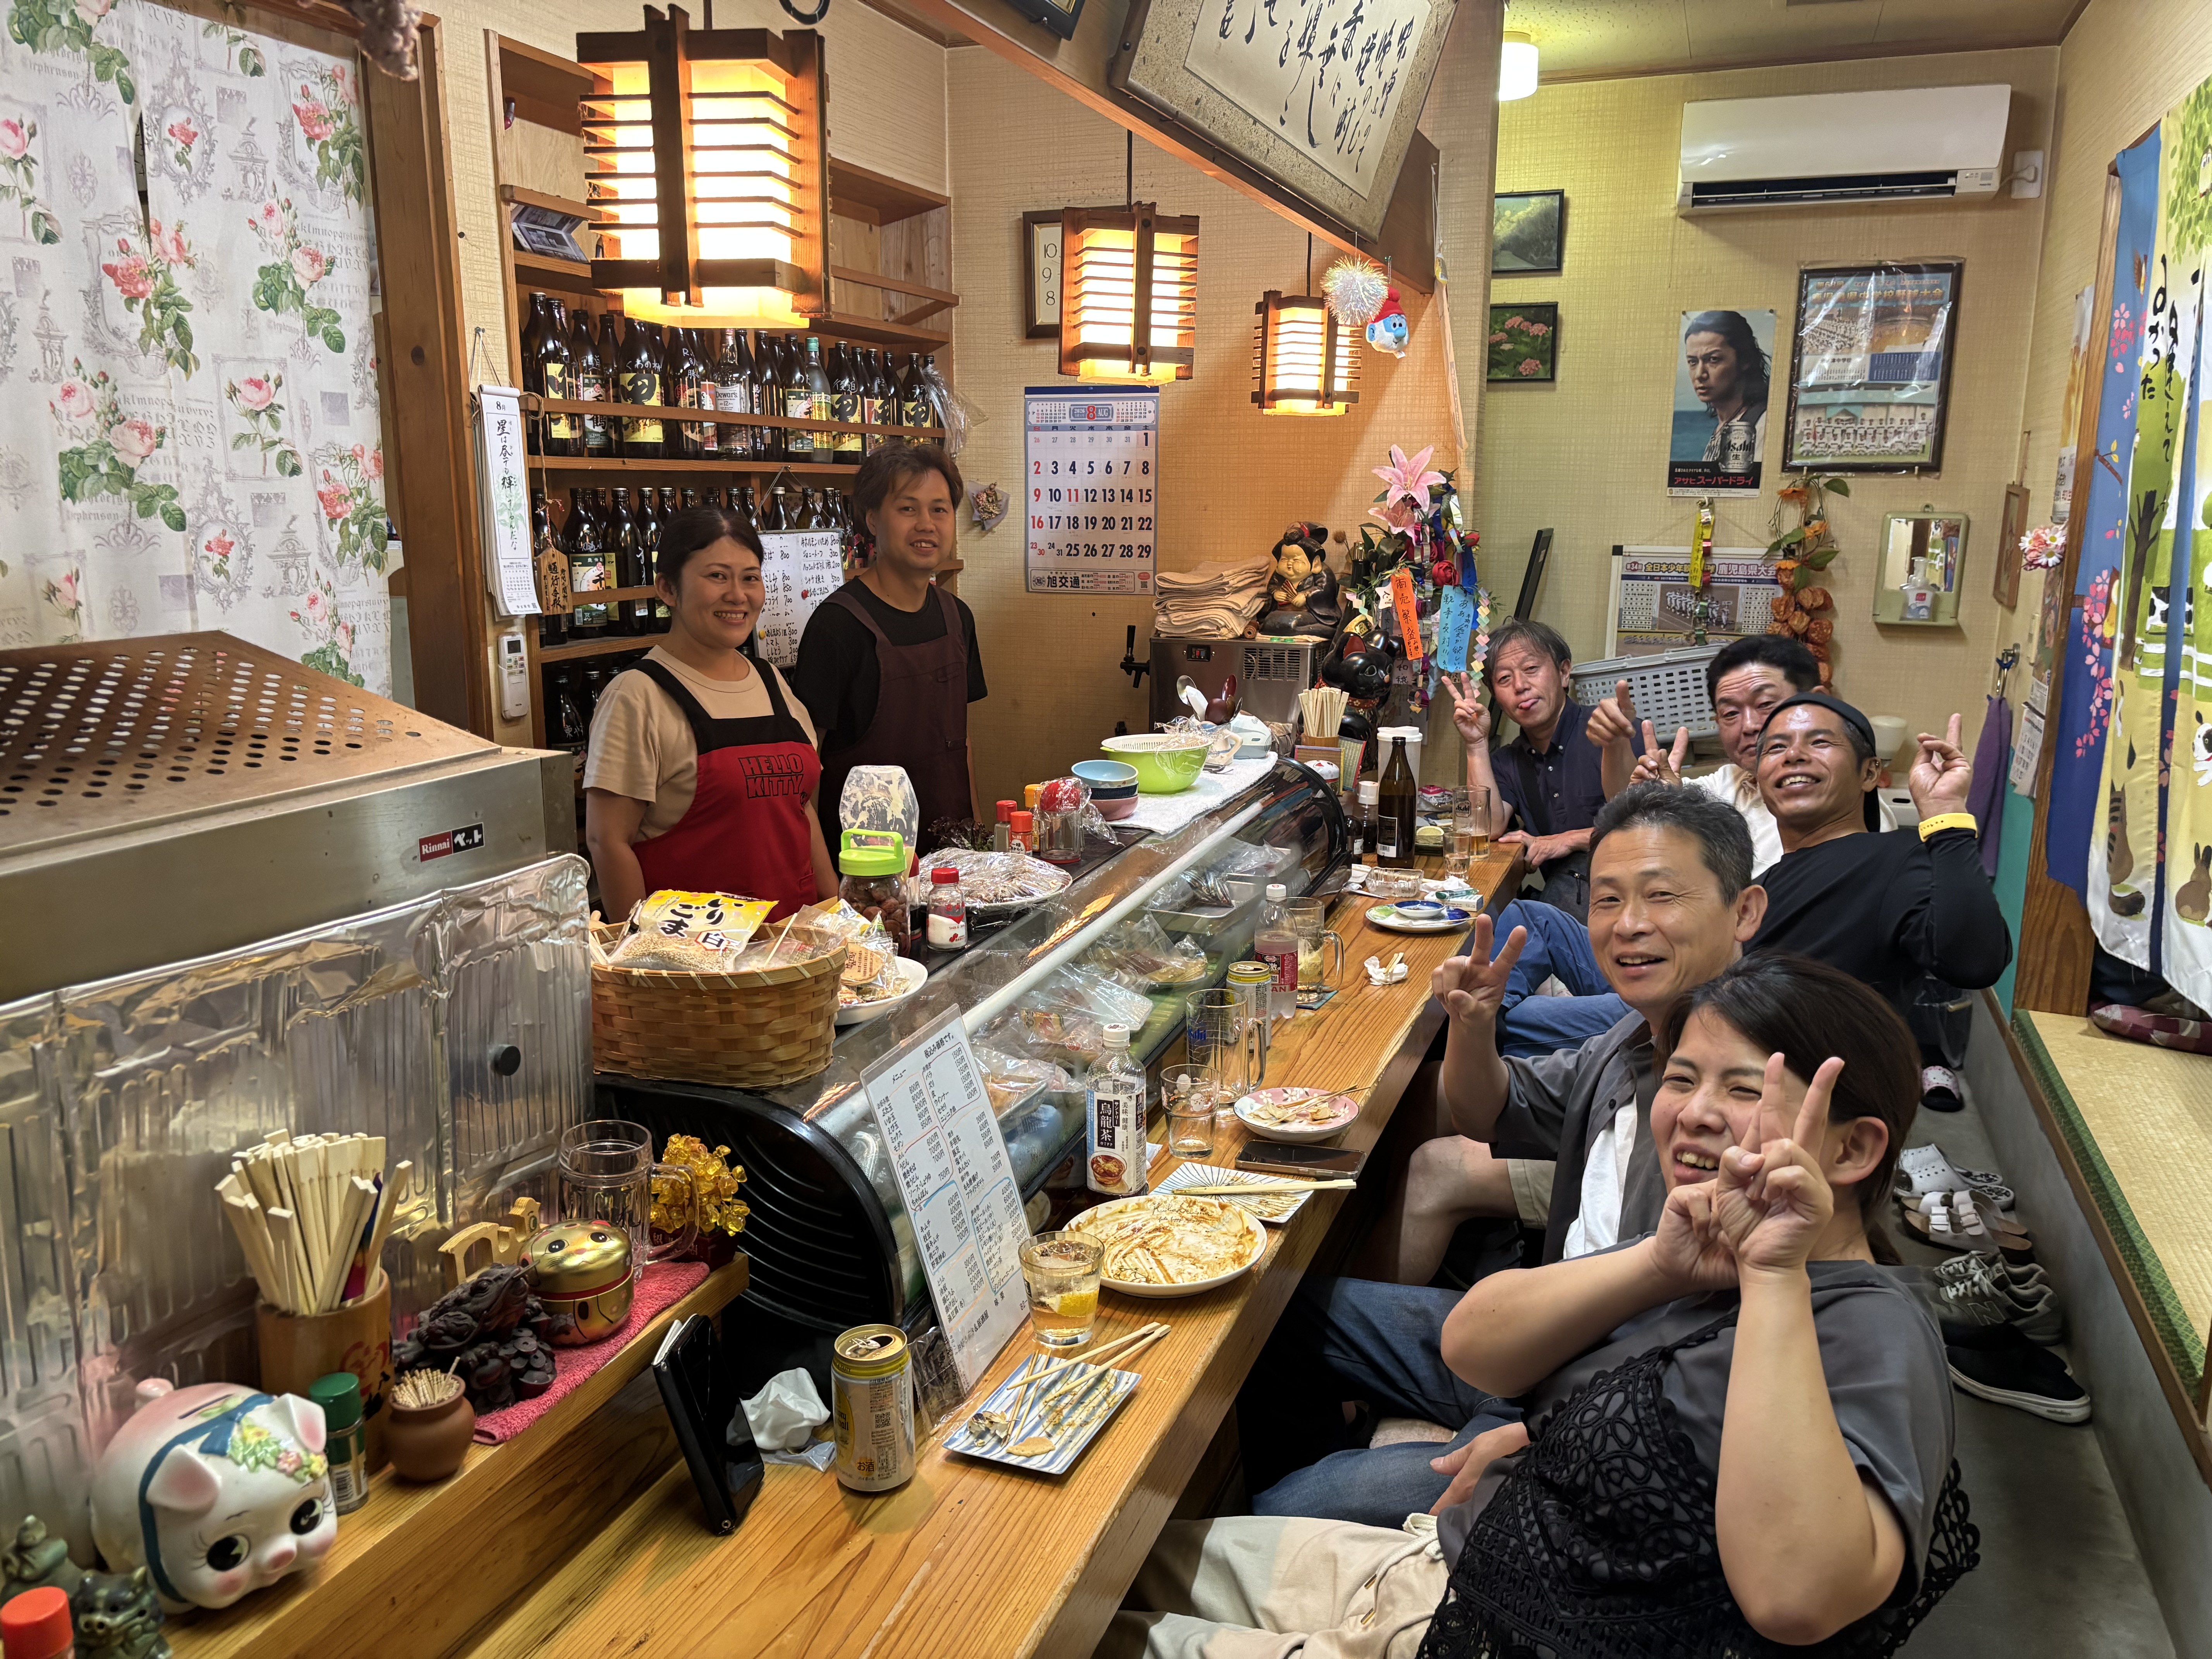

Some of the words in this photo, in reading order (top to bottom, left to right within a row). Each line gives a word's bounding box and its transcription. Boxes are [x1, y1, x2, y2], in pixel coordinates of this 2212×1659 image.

[1044, 243, 1057, 258] 10
[1042, 267, 1052, 283] 9
[1046, 291, 1055, 305] 8
[496, 401, 506, 411] 8月
[1086, 405, 1096, 421] 8
[1097, 408, 1108, 417] AUG
[1144, 432, 1149, 447] 1
[1034, 460, 1041, 475] 2
[1051, 460, 1058, 475] 3
[1069, 460, 1076, 475] 4
[1087, 460, 1094, 475] 5
[1105, 460, 1112, 475] 6
[1124, 460, 1131, 475] 7
[1142, 460, 1149, 475] 8
[1674, 476, 1753, 486] アサヒスーパードライ
[1034, 488, 1041, 503] 9
[1048, 488, 1061, 503] 10
[1067, 488, 1079, 503] 11
[1084, 488, 1097, 503] 12
[1102, 488, 1115, 503] 13
[1120, 488, 1133, 503] 14
[1139, 488, 1152, 503] 15
[1031, 515, 1044, 530] 16
[1048, 515, 1061, 530] 17
[1066, 516, 1079, 531] 18
[1084, 516, 1097, 531] 19
[1102, 516, 1116, 531] 20
[1121, 516, 1133, 531] 21
[1138, 516, 1152, 531] 22
[830, 535, 839, 545] 800
[780, 550, 789, 560] 800
[829, 549, 838, 558] 300
[1066, 543, 1080, 558] 25
[1084, 543, 1097, 558] 26
[1101, 544, 1115, 558] 27
[1119, 544, 1133, 558] 28
[1137, 544, 1152, 559] 29
[782, 572, 790, 582] 800
[1718, 563, 1777, 577] 鹿児島県大会
[831, 573, 840, 583] 500
[1047, 575, 1080, 588] 旭交通
[783, 583, 792, 592] 850
[784, 595, 792, 606] 700
[1396, 577, 1415, 641] 商売繁盛
[788, 627, 797, 636] 300
[766, 638, 779, 647] トマト
[788, 637, 797, 646] 300
[767, 646, 781, 656] ししとう
[738, 753, 804, 775] HELLO
[746, 774, 804, 799] KITTY
[422, 838, 450, 855] Rinnai
[454, 829, 482, 847] ペット
[924, 1032, 954, 1059] 税込み価格です。
[952, 1047, 963, 1060] 150円
[955, 1055, 966, 1068] 150円
[892, 1068, 907, 1084] メニュー
[934, 1091, 950, 1107] ウインナー
[960, 1071, 972, 1084] 150円
[967, 1087, 978, 1100] 400円
[937, 1102, 947, 1115] セセリ
[963, 1079, 975, 1092] 150円
[884, 1112, 896, 1126] いか玉
[979, 1119, 989, 1132] 400円
[1100, 1102, 1112, 1142] 烏龍茶
[887, 1121, 899, 1136] えび玉
[893, 1140, 904, 1152] モダン
[920, 1115, 933, 1130] 950円
[890, 1130, 903, 1144] ミックス
[949, 1134, 961, 1149] 手羽先
[899, 1158, 910, 1172] うどん
[926, 1131, 939, 1147] 600円
[990, 1150, 1001, 1164] 700円
[902, 1162, 917, 1181] 焼きそば
[929, 1140, 942, 1156] 700円
[957, 1158, 971, 1174] めんたい
[905, 1173, 919, 1190] 焼うどん
[932, 1148, 945, 1164] 700円
[938, 1166, 950, 1182] 750円
[1002, 1181, 1012, 1196] 400円
[920, 1219, 931, 1233] キムチ
[948, 1191, 959, 1207] 400円
[1004, 1197, 1017, 1214] 1000円
[1009, 1205, 1019, 1219] 400円
[922, 1230, 932, 1243] 枝豆
[950, 1200, 962, 1216] 400円
[925, 1233, 940, 1253] 豚キムチ
[951, 1209, 963, 1226] 600円
[928, 1245, 939, 1262] 肉ニラ
[954, 1218, 966, 1234] 700円
[931, 1250, 946, 1271] 野菜炒め
[957, 1226, 969, 1243] 700円
[967, 1261, 979, 1277] 400円
[991, 1270, 1000, 1283] コーラ
[970, 1268, 982, 1286] 500円
[857, 1461, 874, 1472] お酒
